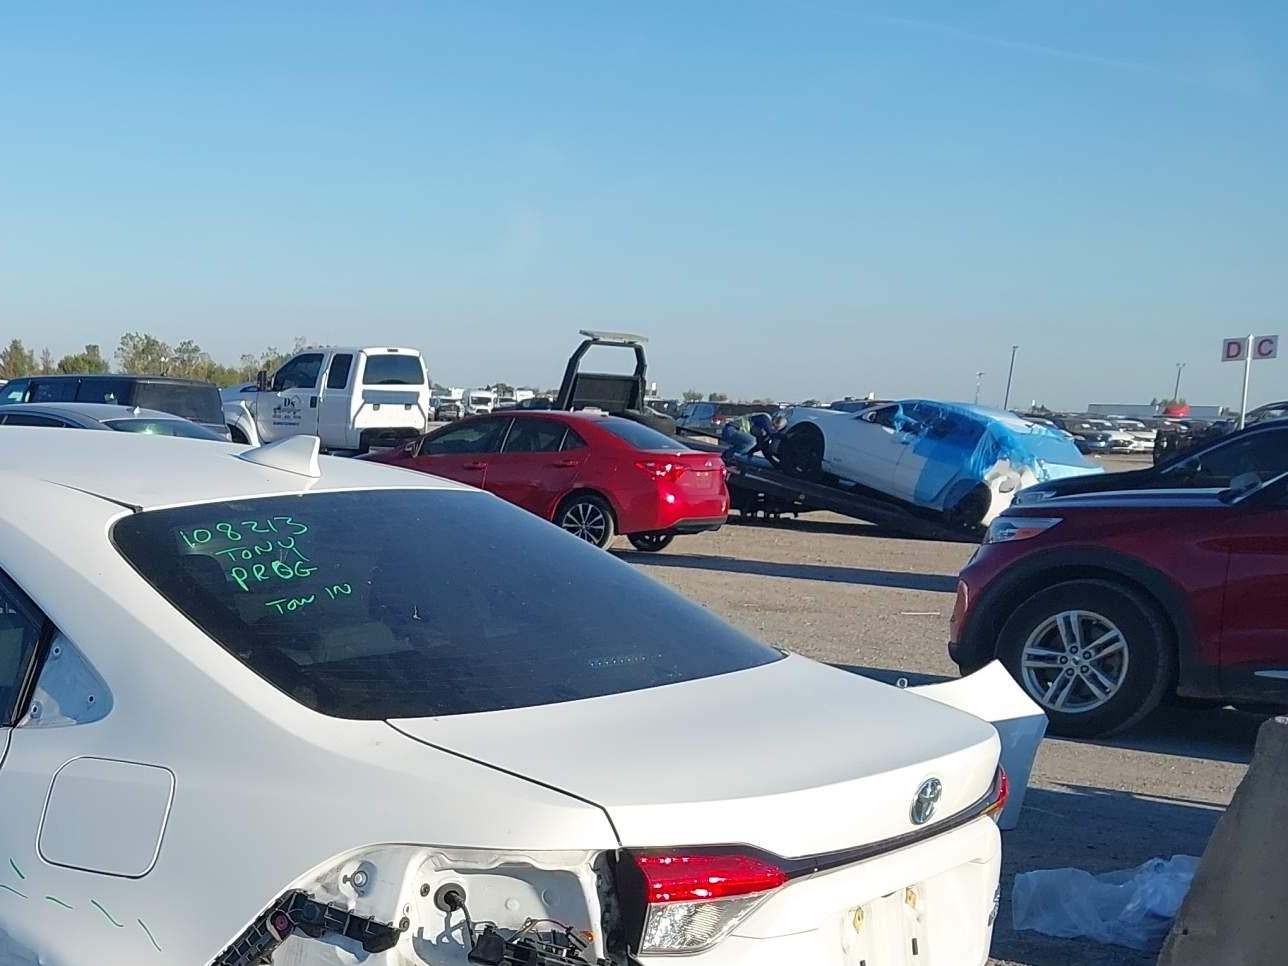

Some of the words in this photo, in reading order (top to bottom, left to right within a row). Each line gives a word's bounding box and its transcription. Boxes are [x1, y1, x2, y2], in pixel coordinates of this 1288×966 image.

[1226, 341, 1241, 358] D
[1257, 338, 1274, 357] C
[179, 516, 308, 549] 108213
